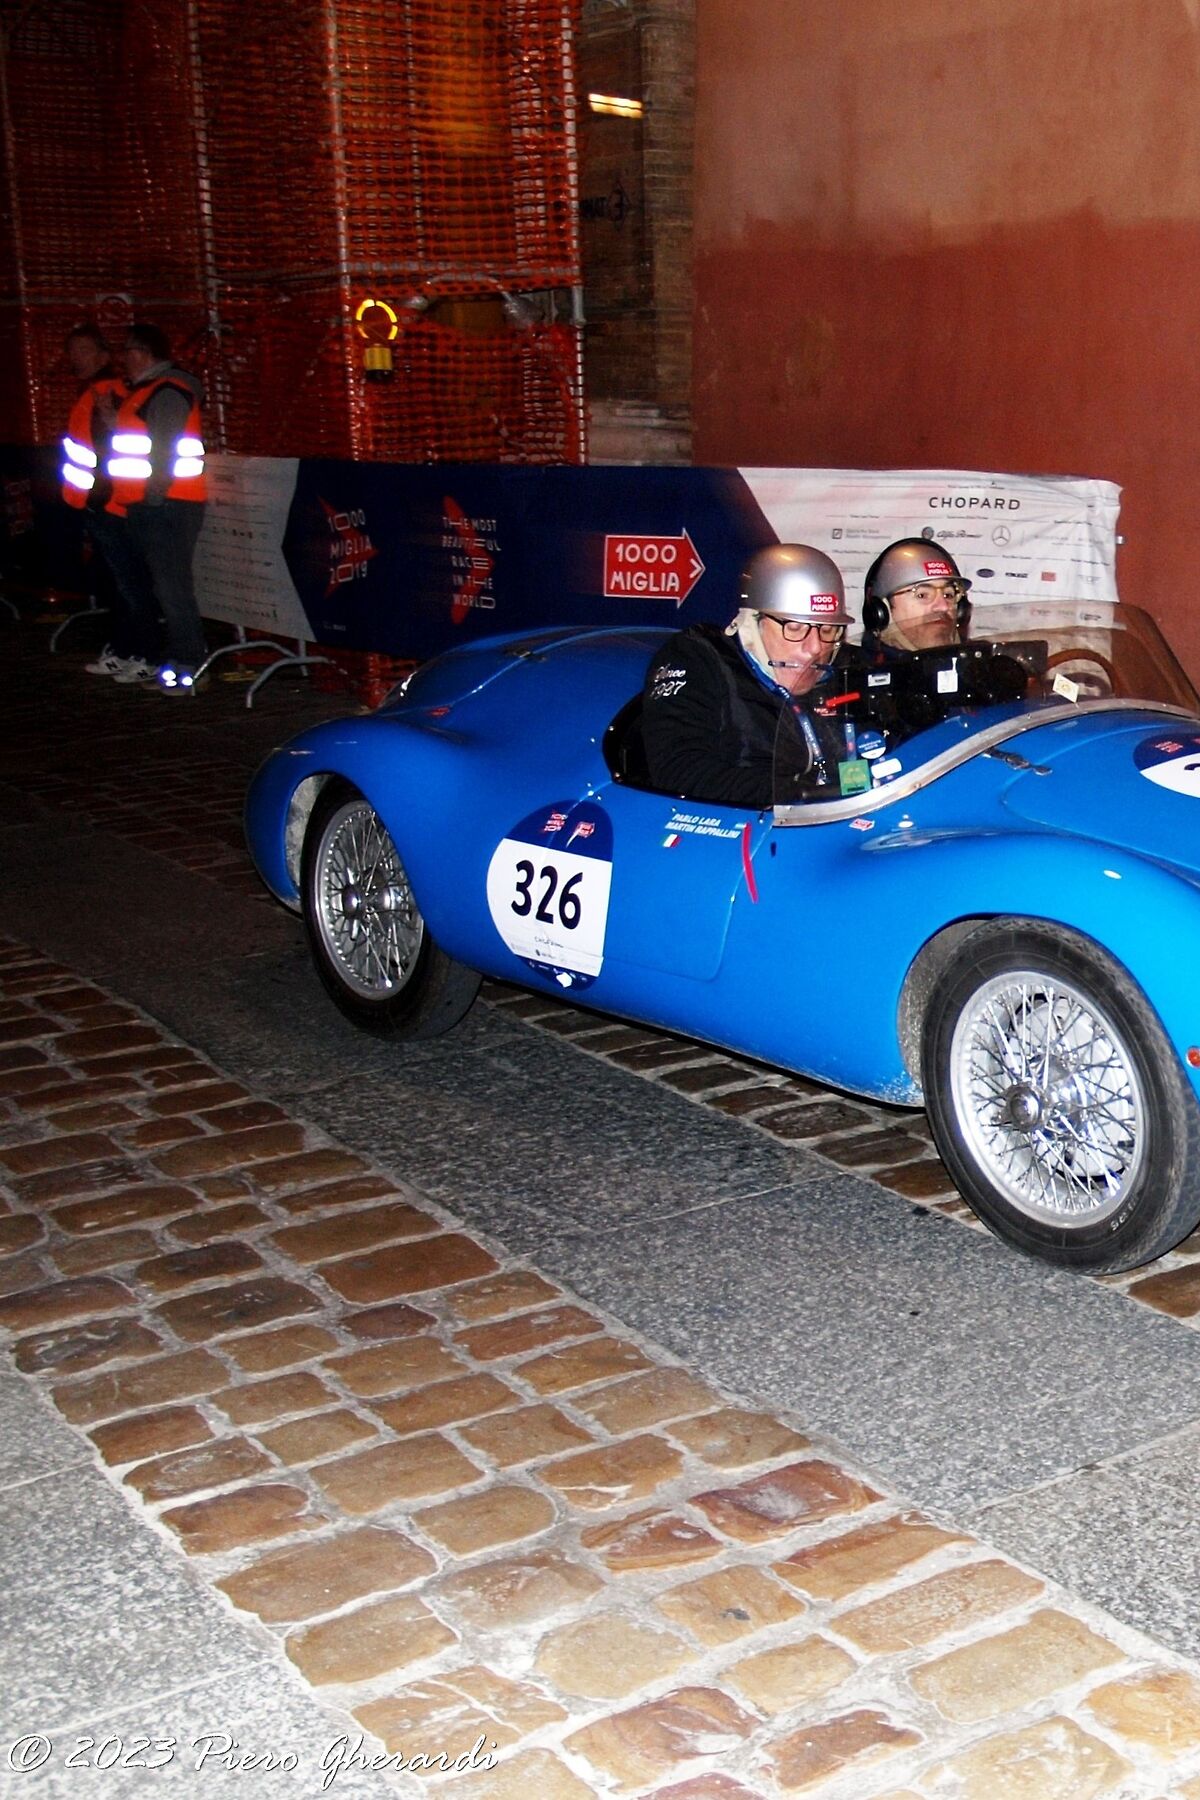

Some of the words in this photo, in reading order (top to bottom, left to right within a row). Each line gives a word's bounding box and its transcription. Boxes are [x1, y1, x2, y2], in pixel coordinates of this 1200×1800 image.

[928, 496, 1021, 511] CHOPARD
[328, 508, 366, 532] 1000
[471, 518, 497, 532] MOST
[330, 534, 372, 559] MIGLIA
[615, 543, 677, 564] 1000
[451, 555, 490, 570] RACE
[610, 571, 680, 593] MIGLIA
[453, 593, 496, 609] WORLD
[664, 821, 697, 833] MARTIN
[698, 816, 722, 827] LARA
[511, 859, 583, 930] 326
